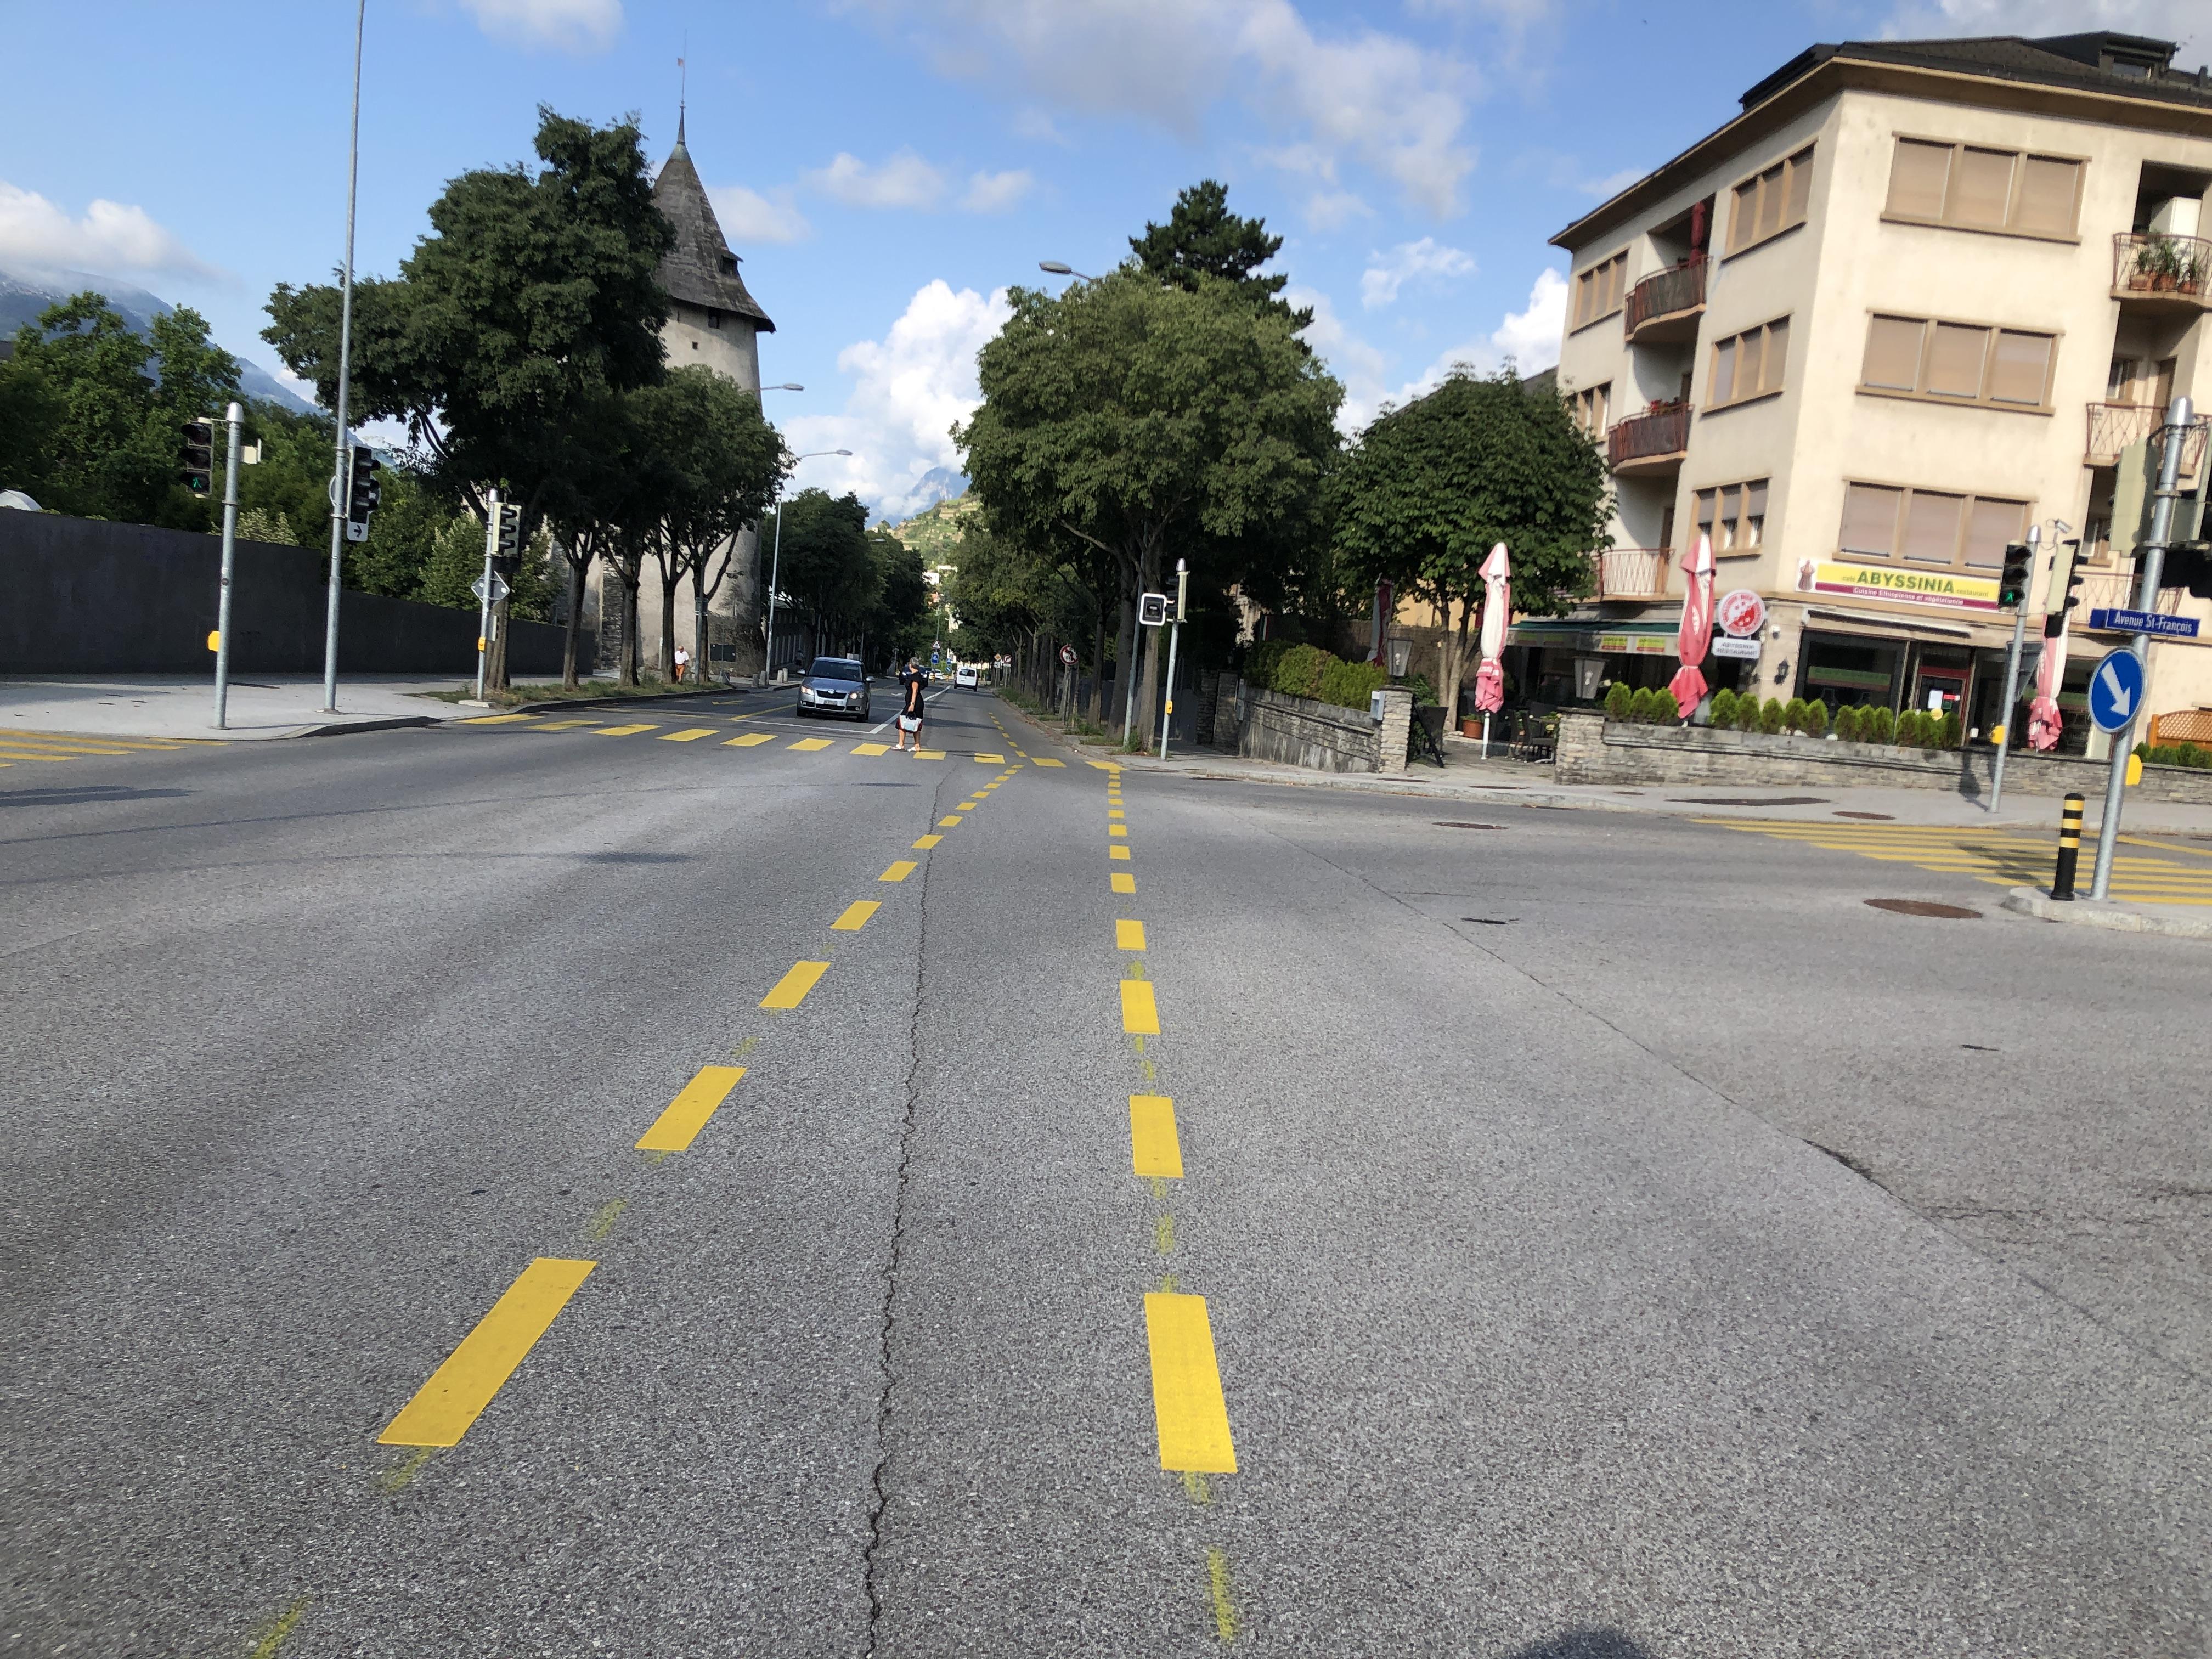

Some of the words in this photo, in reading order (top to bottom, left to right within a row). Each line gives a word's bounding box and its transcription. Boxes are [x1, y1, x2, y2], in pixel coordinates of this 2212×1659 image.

[1854, 587, 1877, 595] Cuisine
[1857, 571, 1954, 594] ABYSSINIA
[1956, 588, 1989, 597] restaurant
[2114, 611, 2143, 627] Avenue
[2146, 614, 2193, 633] St-François
